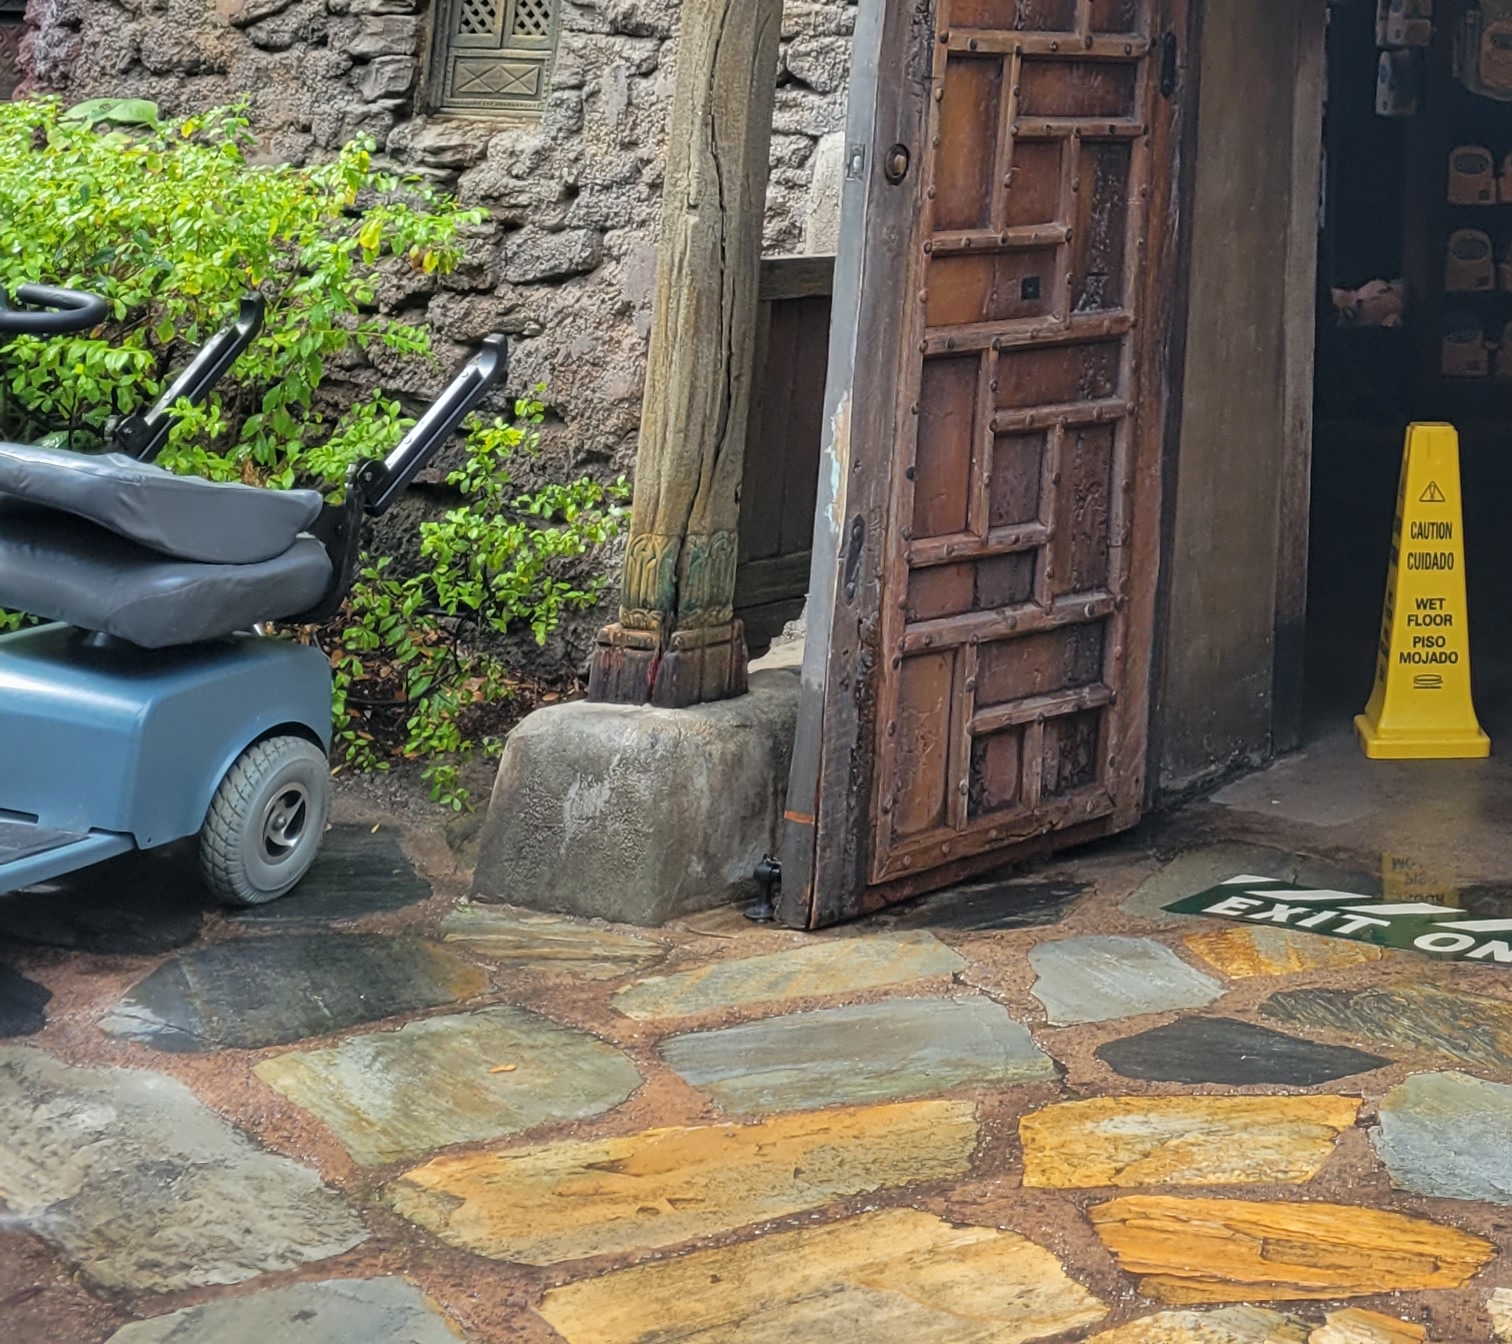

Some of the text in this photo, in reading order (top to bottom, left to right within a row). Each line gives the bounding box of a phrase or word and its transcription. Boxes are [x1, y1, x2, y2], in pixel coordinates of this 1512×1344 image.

[1410, 520, 1452, 540] CAUTION
[1407, 552, 1454, 571] CUIDADO
[1415, 597, 1446, 611] WET
[1407, 613, 1453, 627] FLOOR
[1412, 635, 1446, 649] PISO
[1399, 651, 1459, 665] MOJADO
[1203, 897, 1391, 933] EXIT
